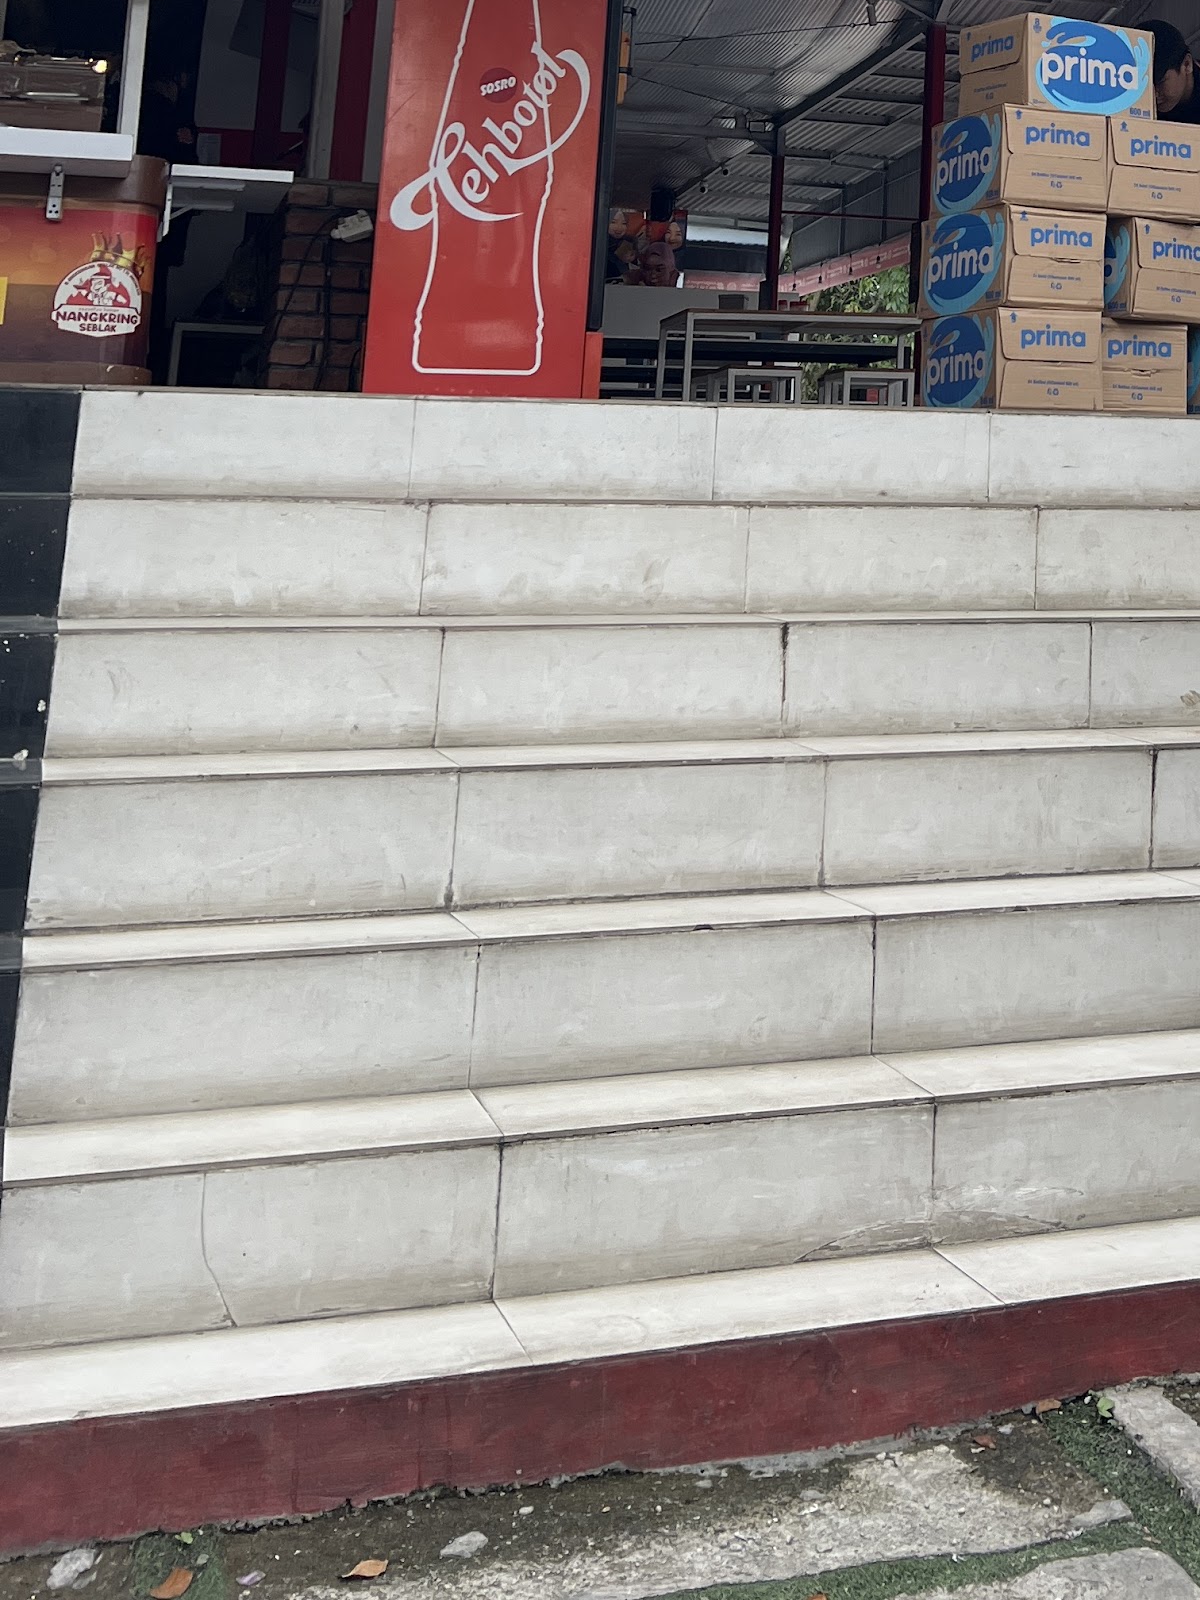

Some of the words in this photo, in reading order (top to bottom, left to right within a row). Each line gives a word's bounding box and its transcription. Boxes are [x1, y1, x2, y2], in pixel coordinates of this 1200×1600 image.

[971, 34, 1014, 62] prima
[1042, 48, 1139, 90] prima
[479, 76, 517, 97] SOSRO
[389, 40, 591, 231] Tehbotol
[1025, 123, 1090, 147] prima
[1131, 135, 1191, 159] prima
[936, 146, 992, 195] prima
[1030, 223, 1093, 248] prima
[927, 242, 994, 290] prima
[56, 311, 138, 325] NANGKRING
[79, 323, 117, 333] SEBLAK
[1021, 324, 1086, 349] prima
[1107, 334, 1172, 359] prima
[926, 345, 986, 393] prima
